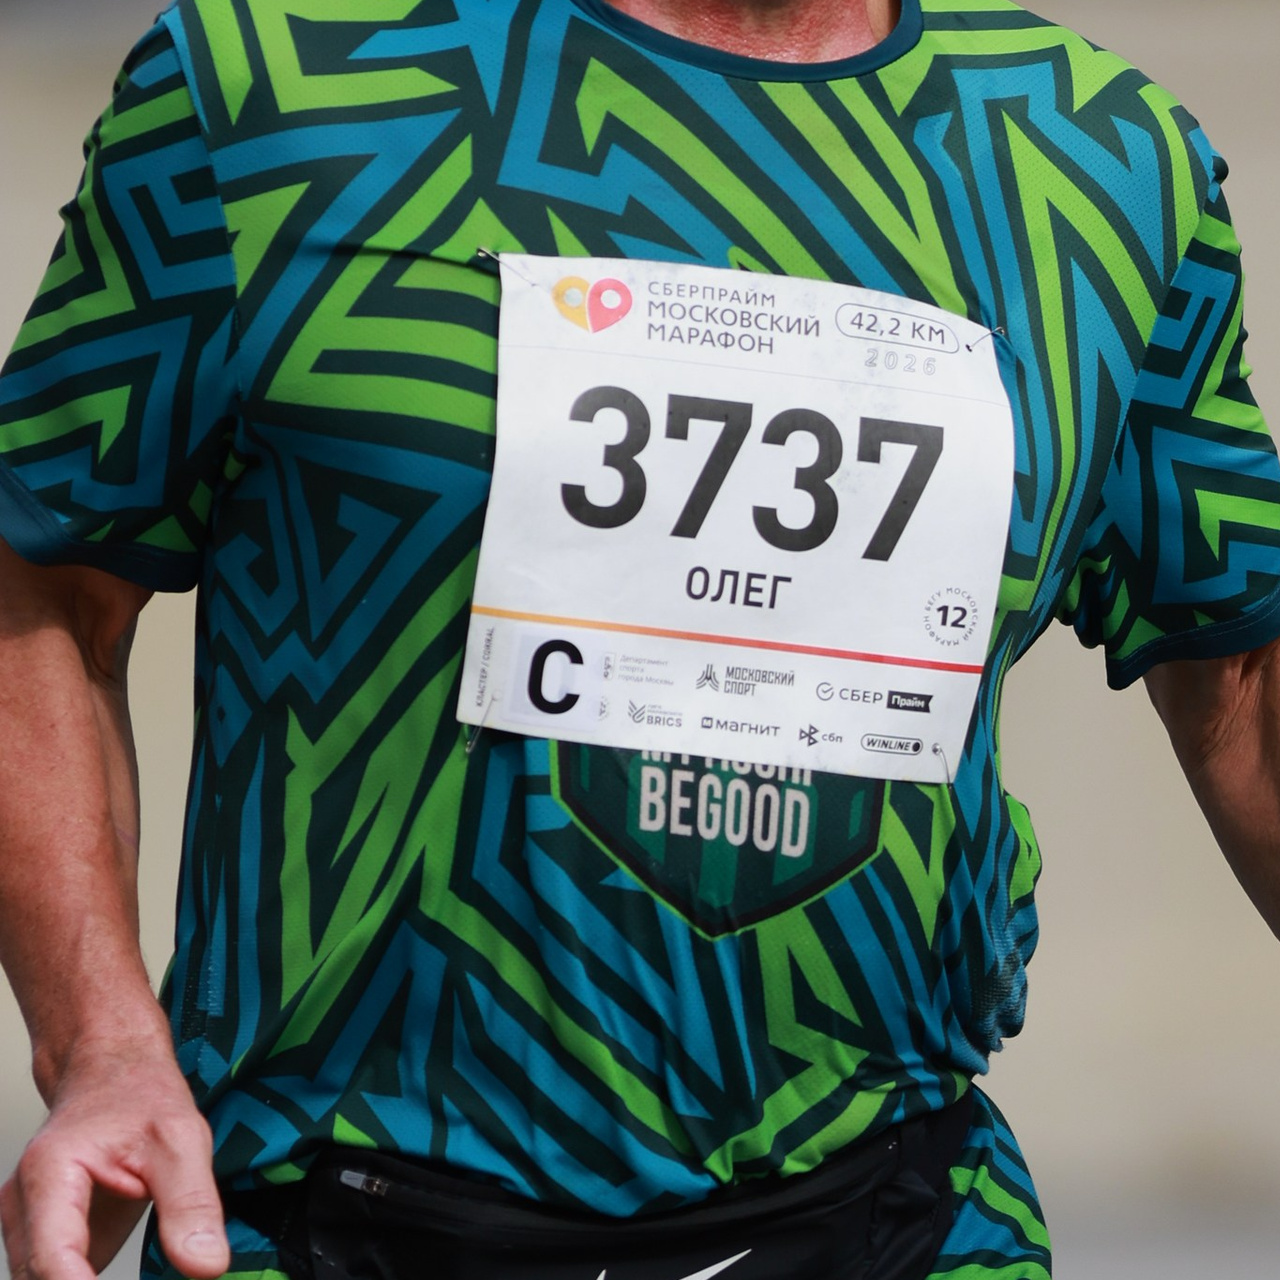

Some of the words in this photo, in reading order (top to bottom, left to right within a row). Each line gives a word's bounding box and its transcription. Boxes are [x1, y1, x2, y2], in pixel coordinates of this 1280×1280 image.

[648, 281, 776, 308] СБЕРПРАЙМ
[648, 301, 821, 338] МОСКОВСКИЙ
[849, 311, 901, 337] 42,2
[911, 322, 946, 345] КМ
[648, 323, 774, 355] МАРАФОН
[864, 348, 937, 376] 2026
[560, 385, 944, 562] 3737
[686, 565, 792, 610] ОЛЕГ
[936, 605, 967, 628] 12
[723, 681, 757, 696] СПОРТ
[725, 666, 795, 686] МОСКОВСКИЙ
[839, 688, 883, 704] СБЕР
[647, 715, 682, 727] BRICS
[715, 719, 780, 737] магнит
[821, 732, 843, 743] сбп
[866, 737, 911, 751] WINLINE
[639, 765, 810, 858] BEGOOD
